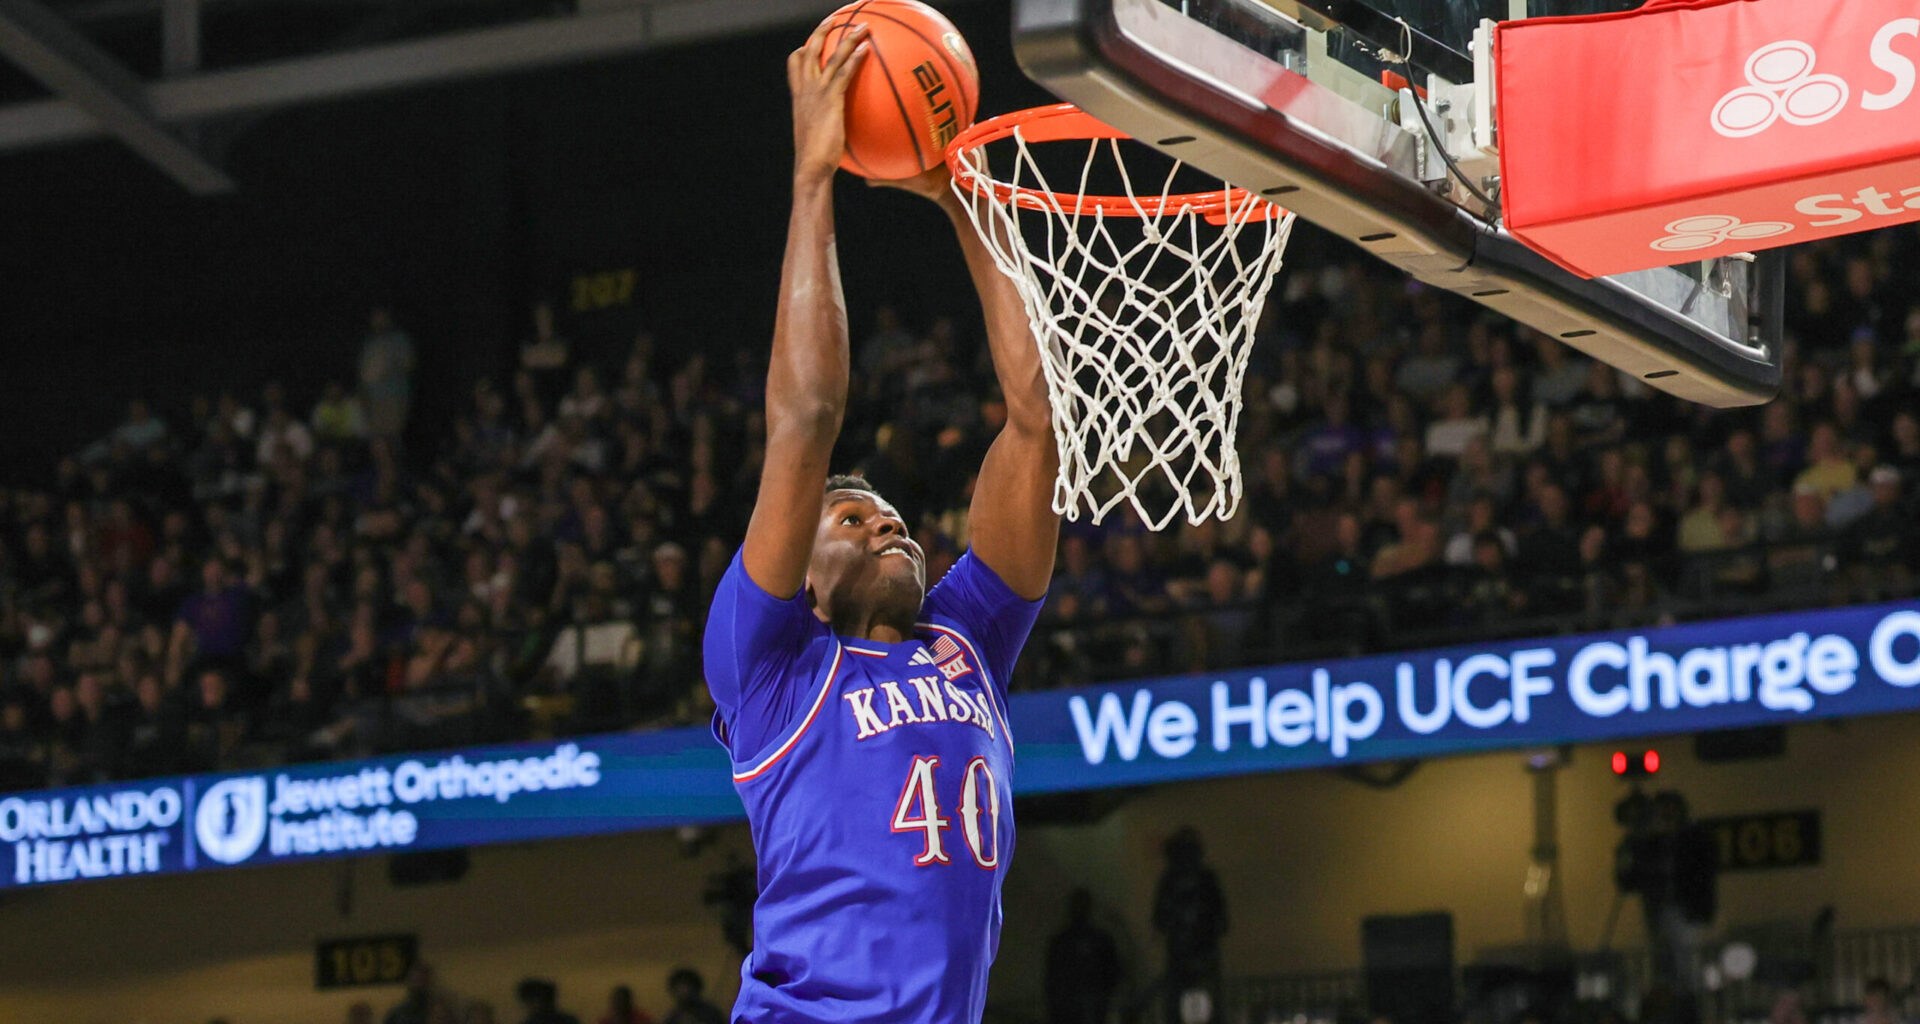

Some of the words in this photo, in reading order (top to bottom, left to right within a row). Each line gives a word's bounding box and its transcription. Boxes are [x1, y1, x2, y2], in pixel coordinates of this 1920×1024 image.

[1860, 17, 1920, 111] S
[912, 60, 959, 149] ELITE
[844, 675, 995, 740] KANSAS
[1069, 688, 1198, 765] We
[1211, 667, 1385, 758] Help
[1396, 648, 1557, 735] UCF
[1567, 632, 1860, 717] Charge
[0, 787, 182, 842] ORLANDO
[269, 773, 394, 815] Jewett
[394, 742, 600, 803] Orthopedic
[890, 754, 999, 870] 40
[16, 831, 160, 884] HEALTH
[269, 806, 419, 856] Institute
